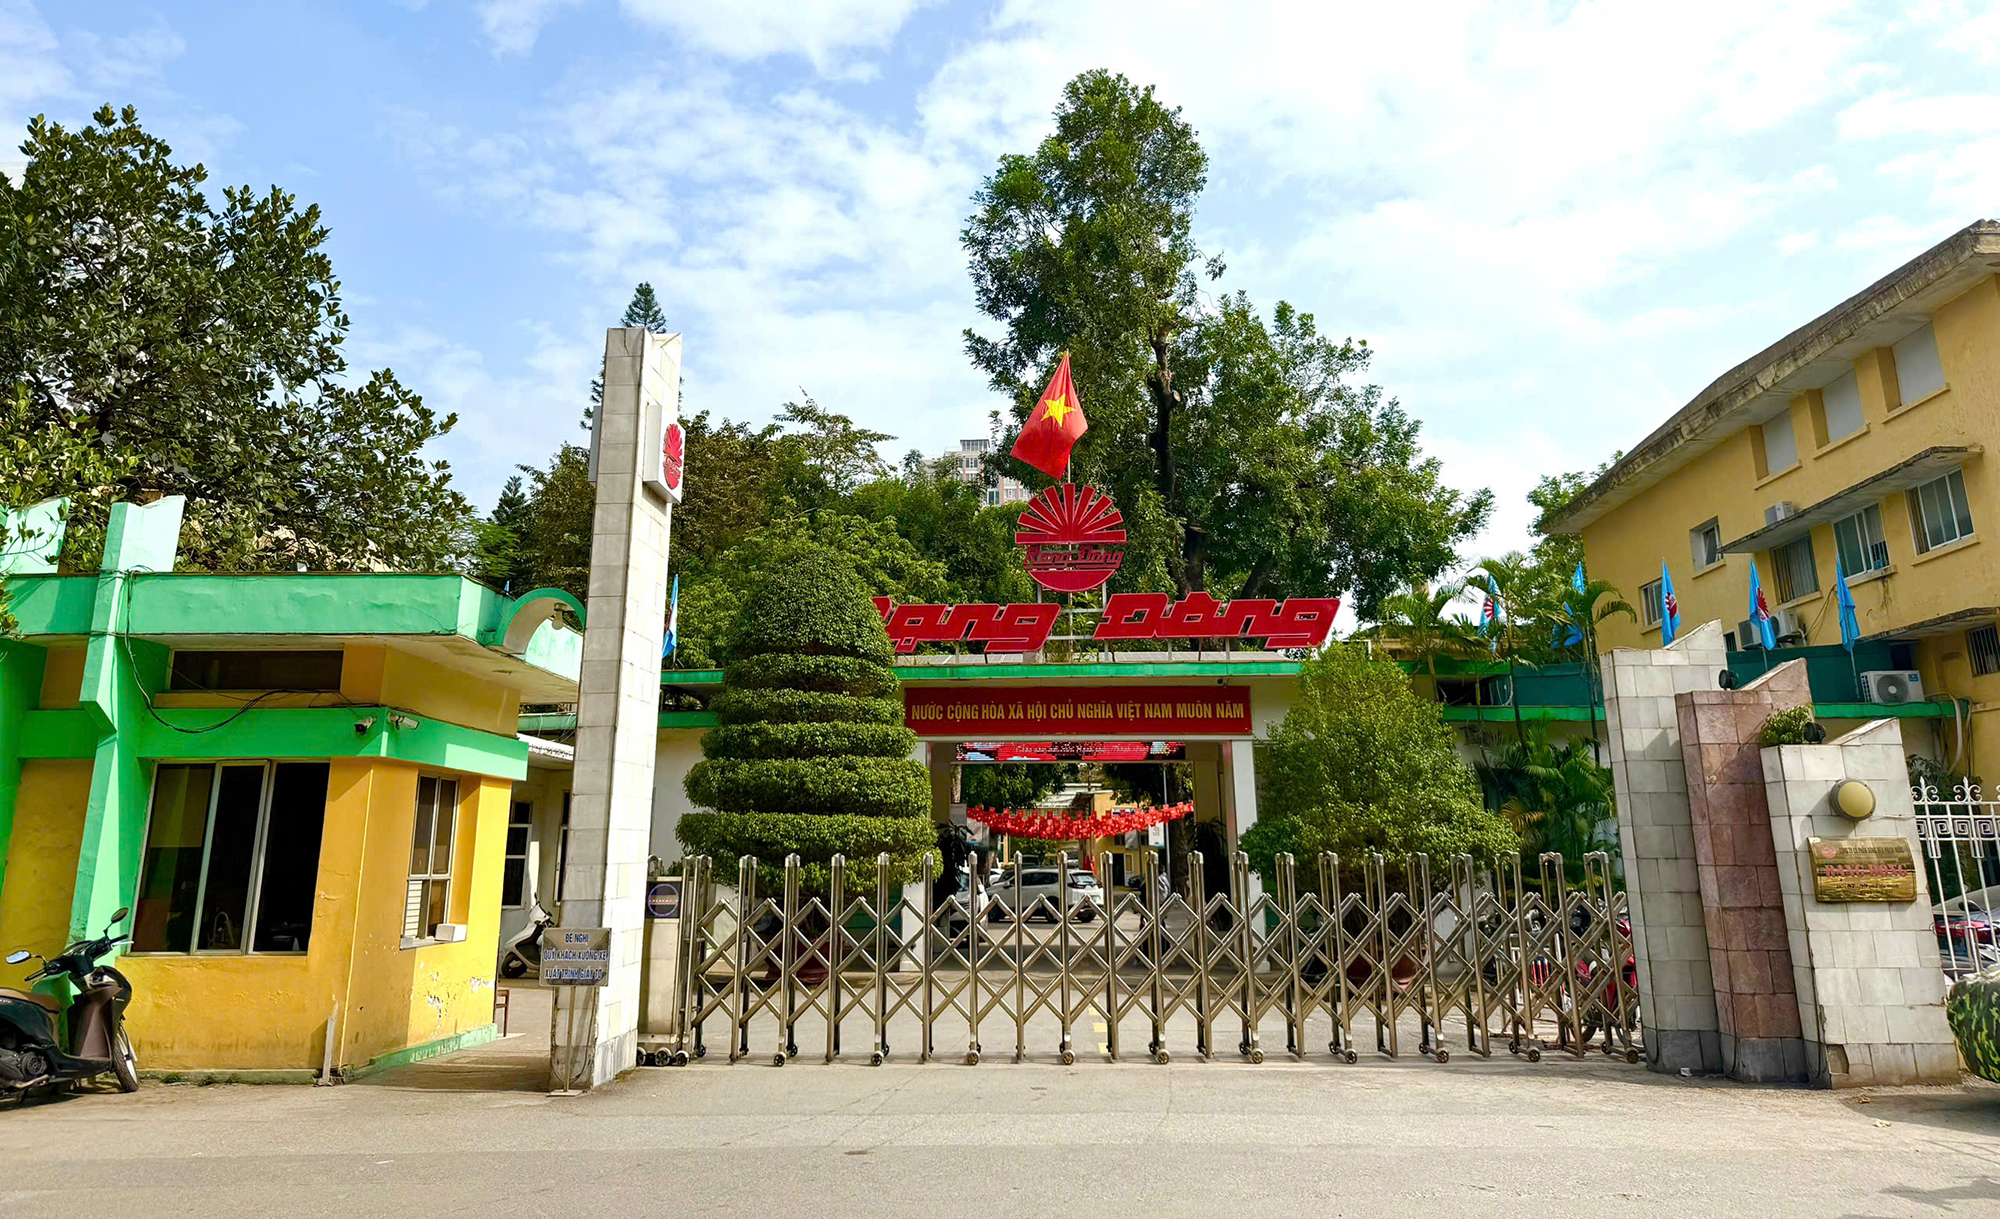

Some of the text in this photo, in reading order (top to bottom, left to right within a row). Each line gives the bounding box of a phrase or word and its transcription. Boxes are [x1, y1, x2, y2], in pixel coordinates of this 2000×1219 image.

[1092, 591, 1341, 649] Đông
[911, 699, 1245, 722] NƯỚC CỘNG HÒA XÃ HỘI CHỦ NGHĨA VIỆT NAM MUÔN NĂM
[543, 948, 556, 961] QUÝ
[557, 949, 577, 961] KHÁCH
[598, 950, 607, 961] XE
